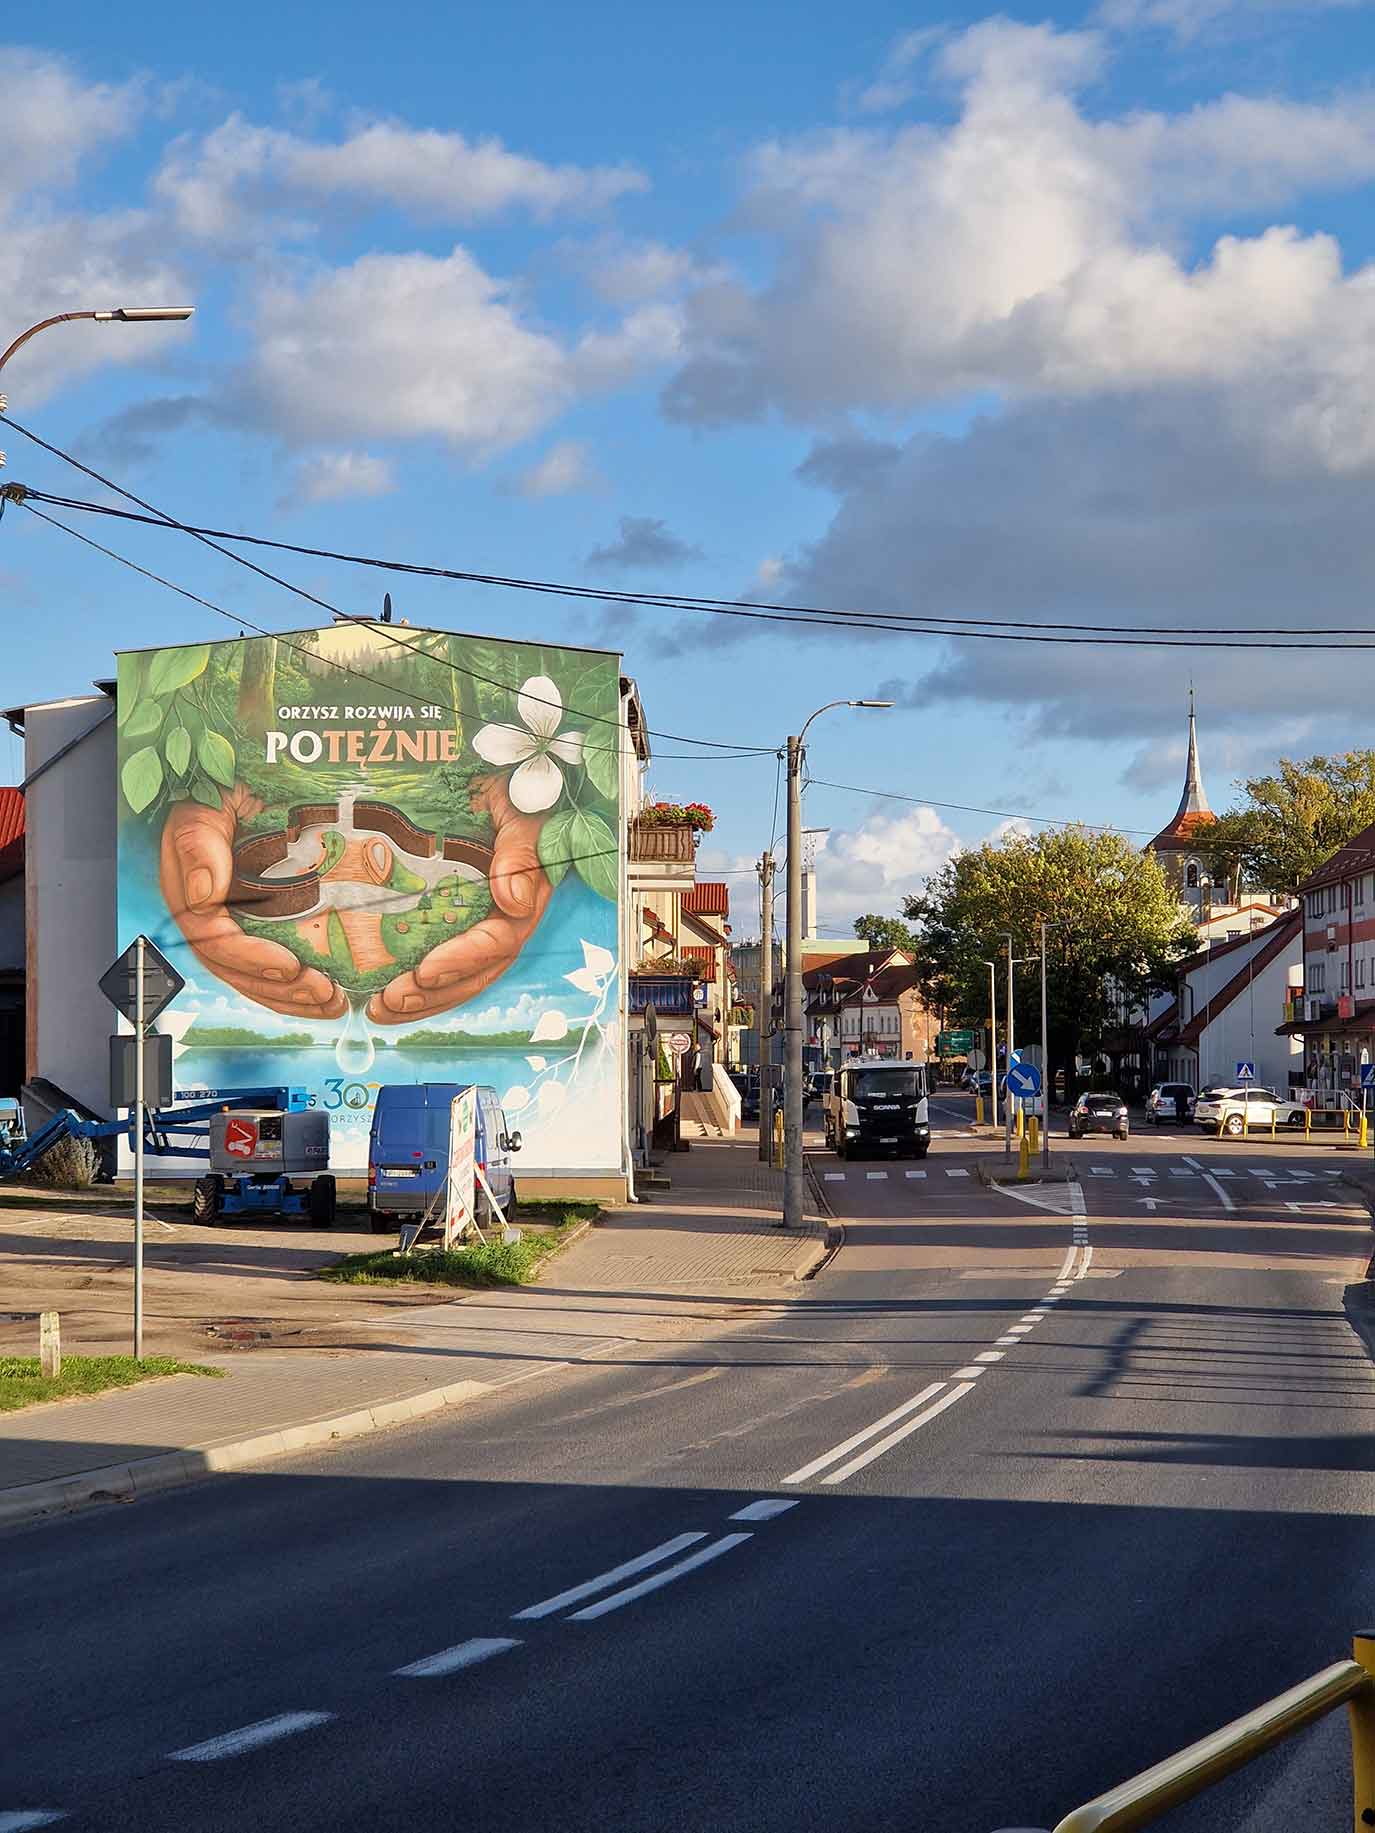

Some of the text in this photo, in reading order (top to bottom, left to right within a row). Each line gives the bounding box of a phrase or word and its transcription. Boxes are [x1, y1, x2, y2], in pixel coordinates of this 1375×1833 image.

[278, 705, 442, 722] ORZYSZ ROZWIJA SIĘ
[265, 719, 461, 769] POTĘŻNIE
